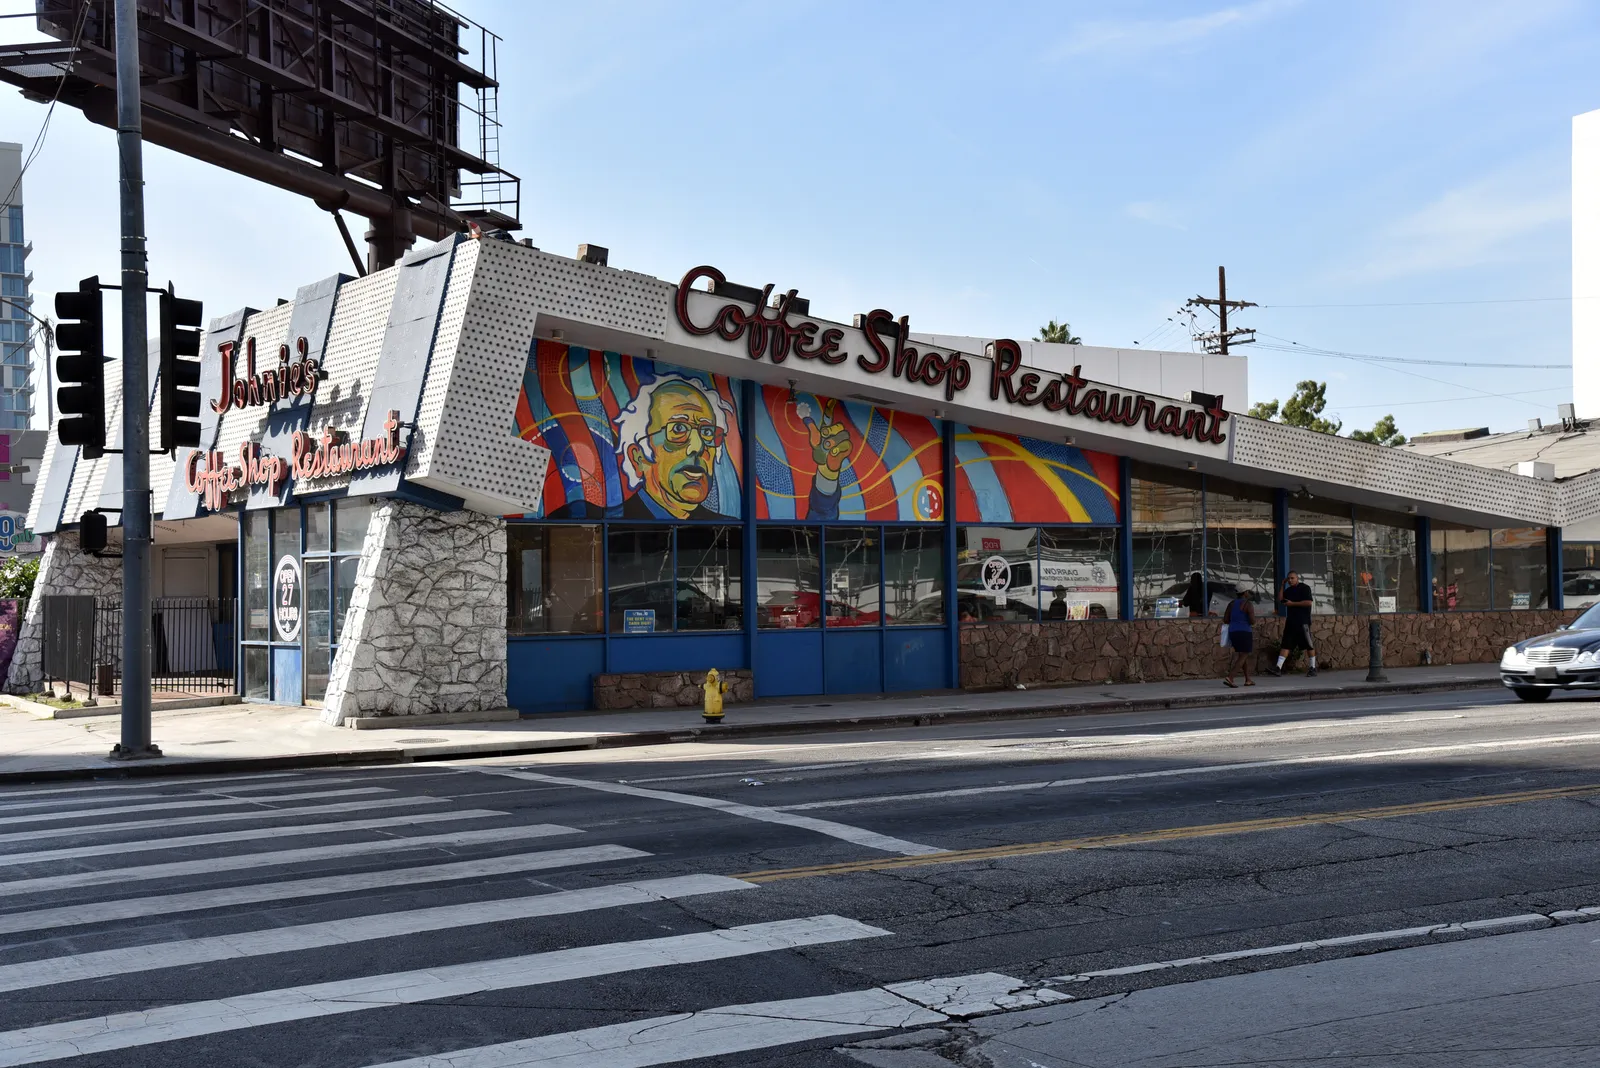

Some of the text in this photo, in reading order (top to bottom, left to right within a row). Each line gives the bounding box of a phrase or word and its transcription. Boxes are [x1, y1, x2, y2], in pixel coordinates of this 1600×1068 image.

[210, 336, 320, 415] Johnie's
[675, 265, 1230, 444] Coffee Shop Restaurant
[185, 409, 401, 512] Coffee Shop Restaurant
[280, 569, 295, 583] OPEN
[282, 584, 294, 606] 27
[278, 607, 298, 621] HOURS
